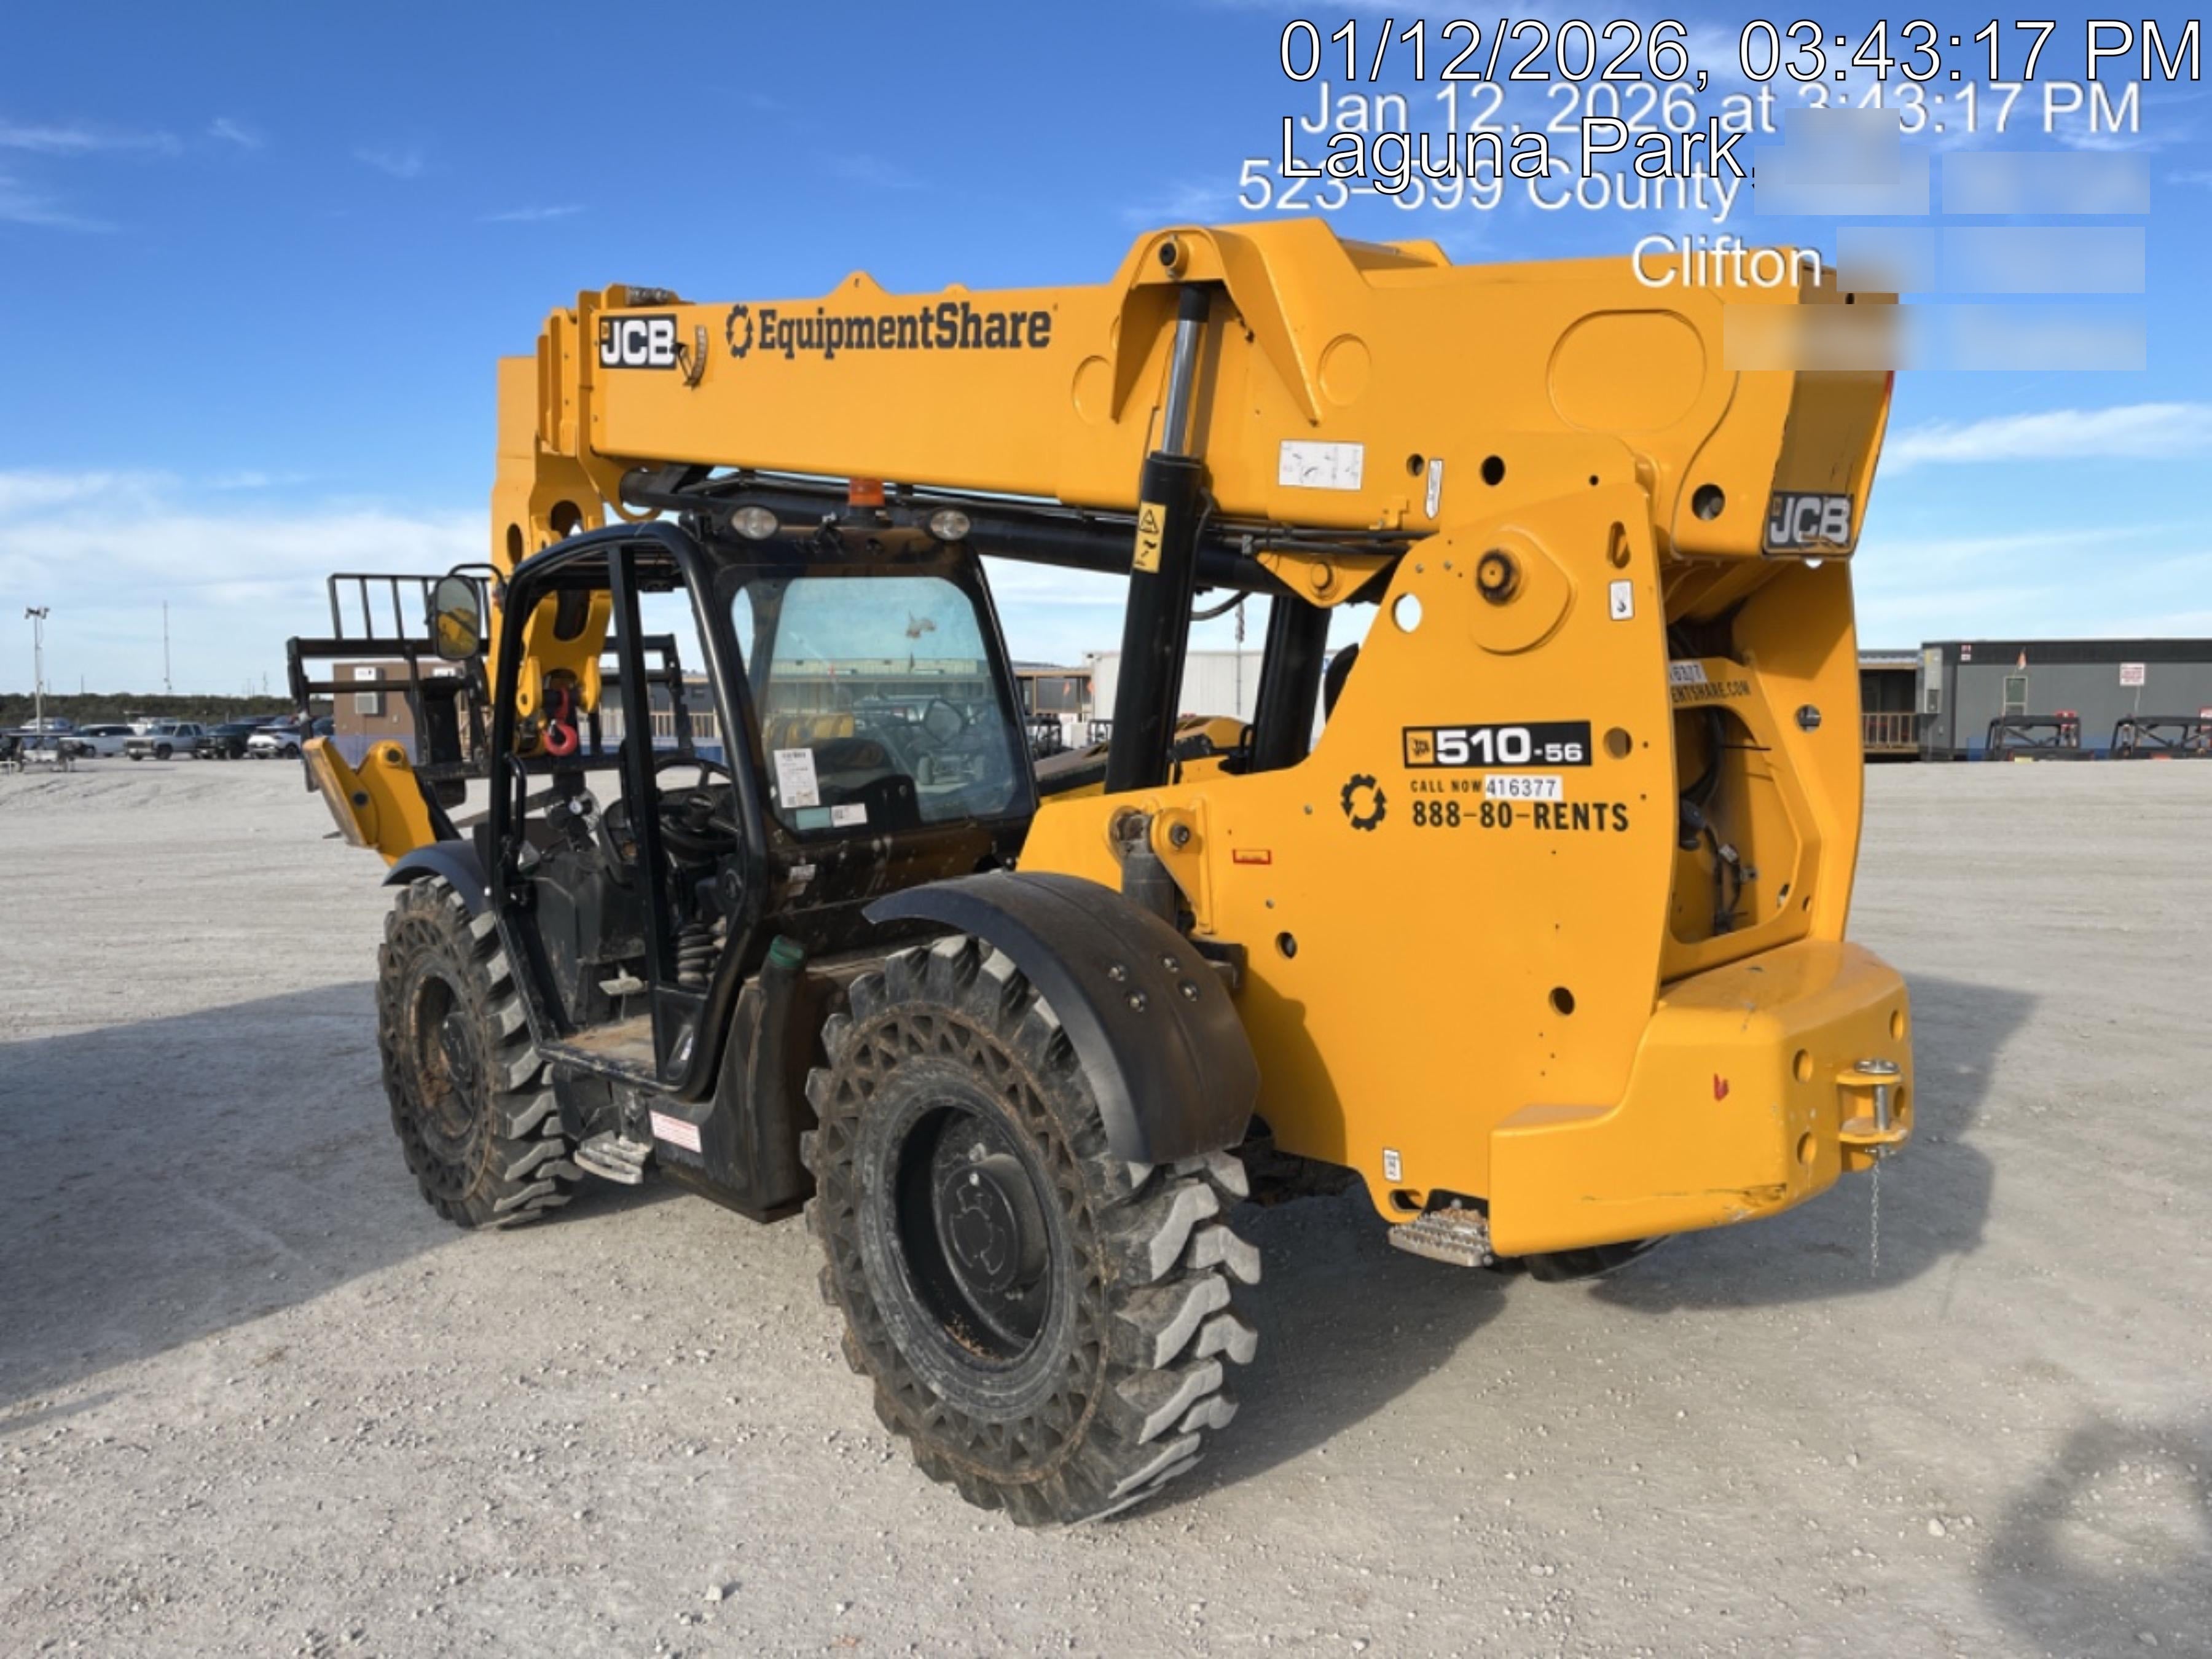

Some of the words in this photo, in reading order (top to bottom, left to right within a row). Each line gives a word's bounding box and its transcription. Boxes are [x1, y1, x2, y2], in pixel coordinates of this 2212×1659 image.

[600, 320, 675, 364] JCB
[758, 301, 1051, 359] EquipmentShare
[1770, 496, 1851, 544] JCB
[1436, 728, 1583, 764] 510-56
[1410, 780, 1444, 793] CALL
[1451, 780, 1482, 793] NOW
[1486, 778, 1557, 797] 416377
[1413, 801, 1630, 832] 888-80-RENTS
